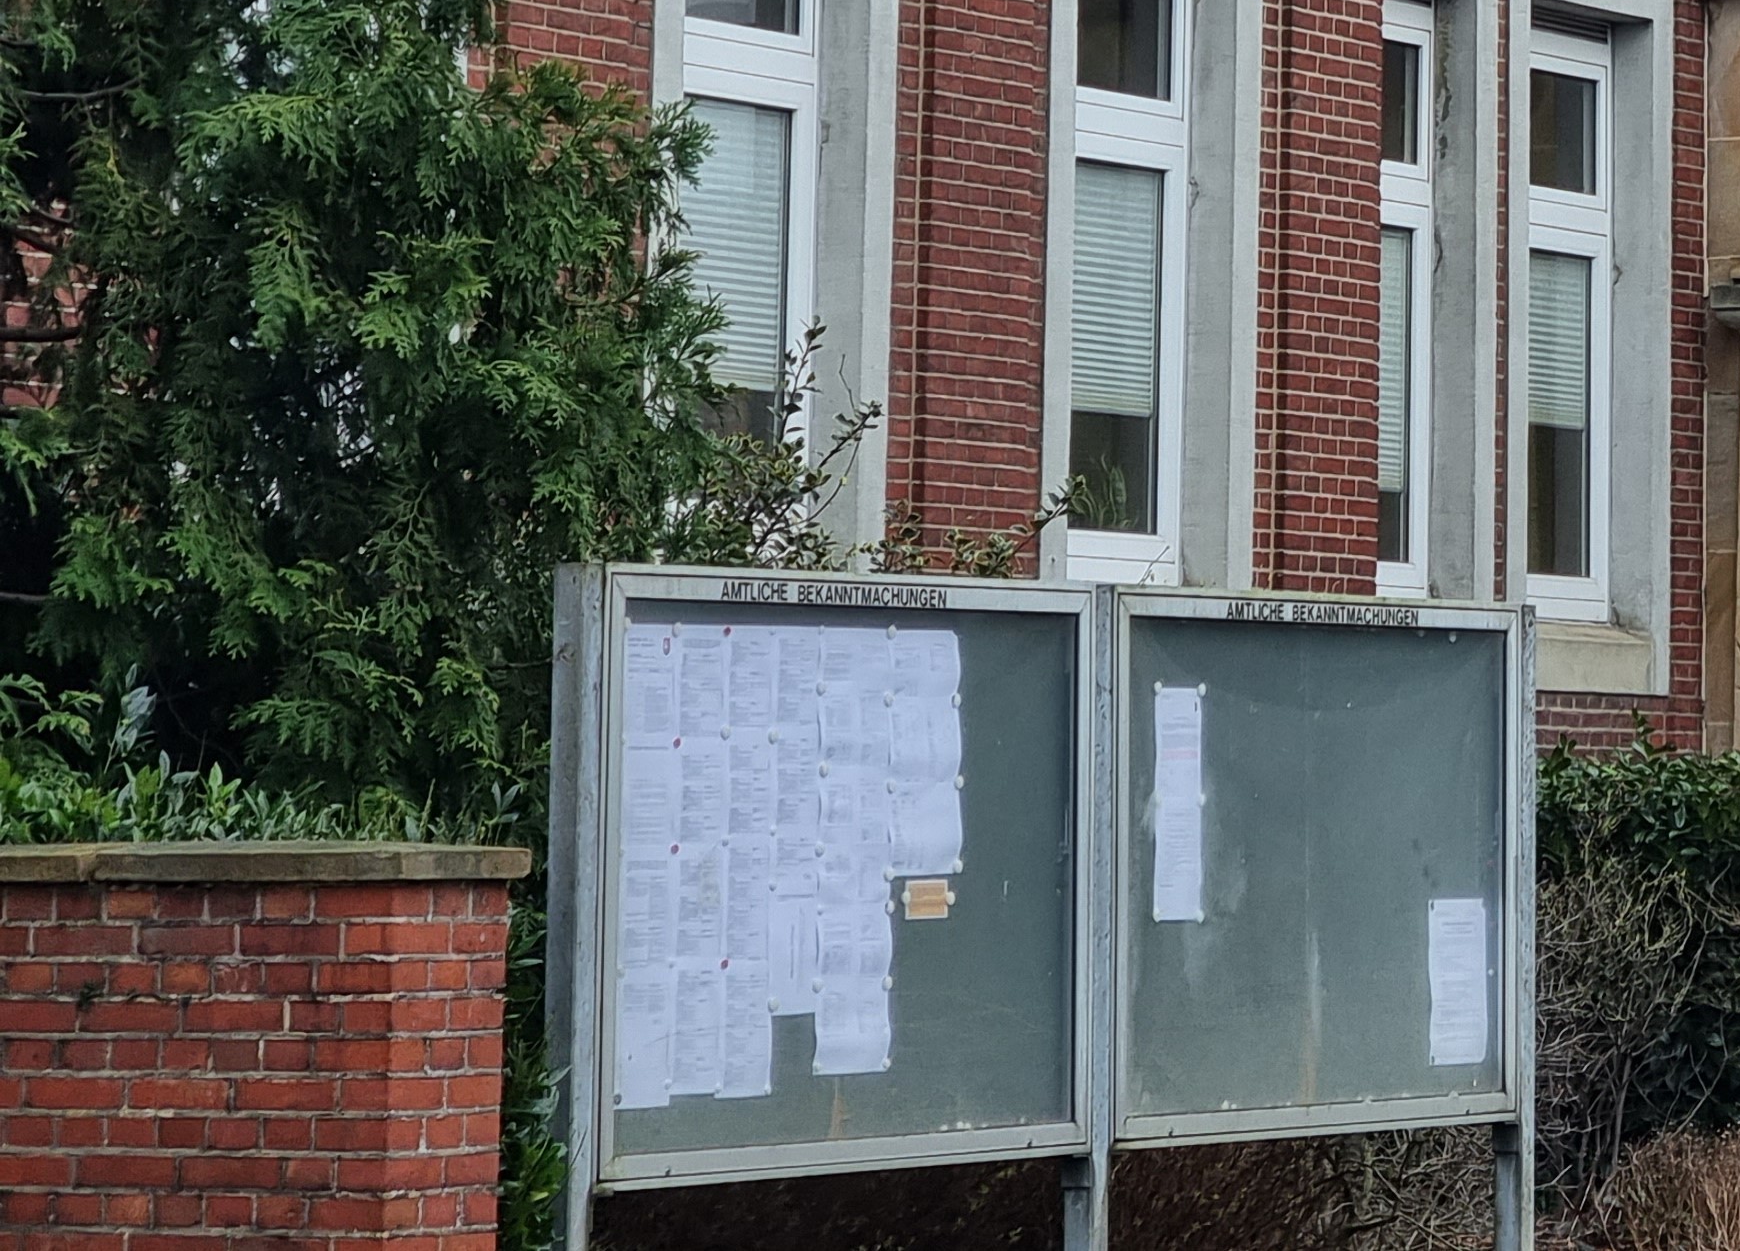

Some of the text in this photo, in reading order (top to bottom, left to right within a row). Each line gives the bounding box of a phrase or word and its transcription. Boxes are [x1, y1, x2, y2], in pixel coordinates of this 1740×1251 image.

[721, 581, 947, 608] AMTLICHE BEKANNTMACHUNGEN
[1226, 602, 1419, 626] AMTLICHE BEKANNTMACHUNGEN
